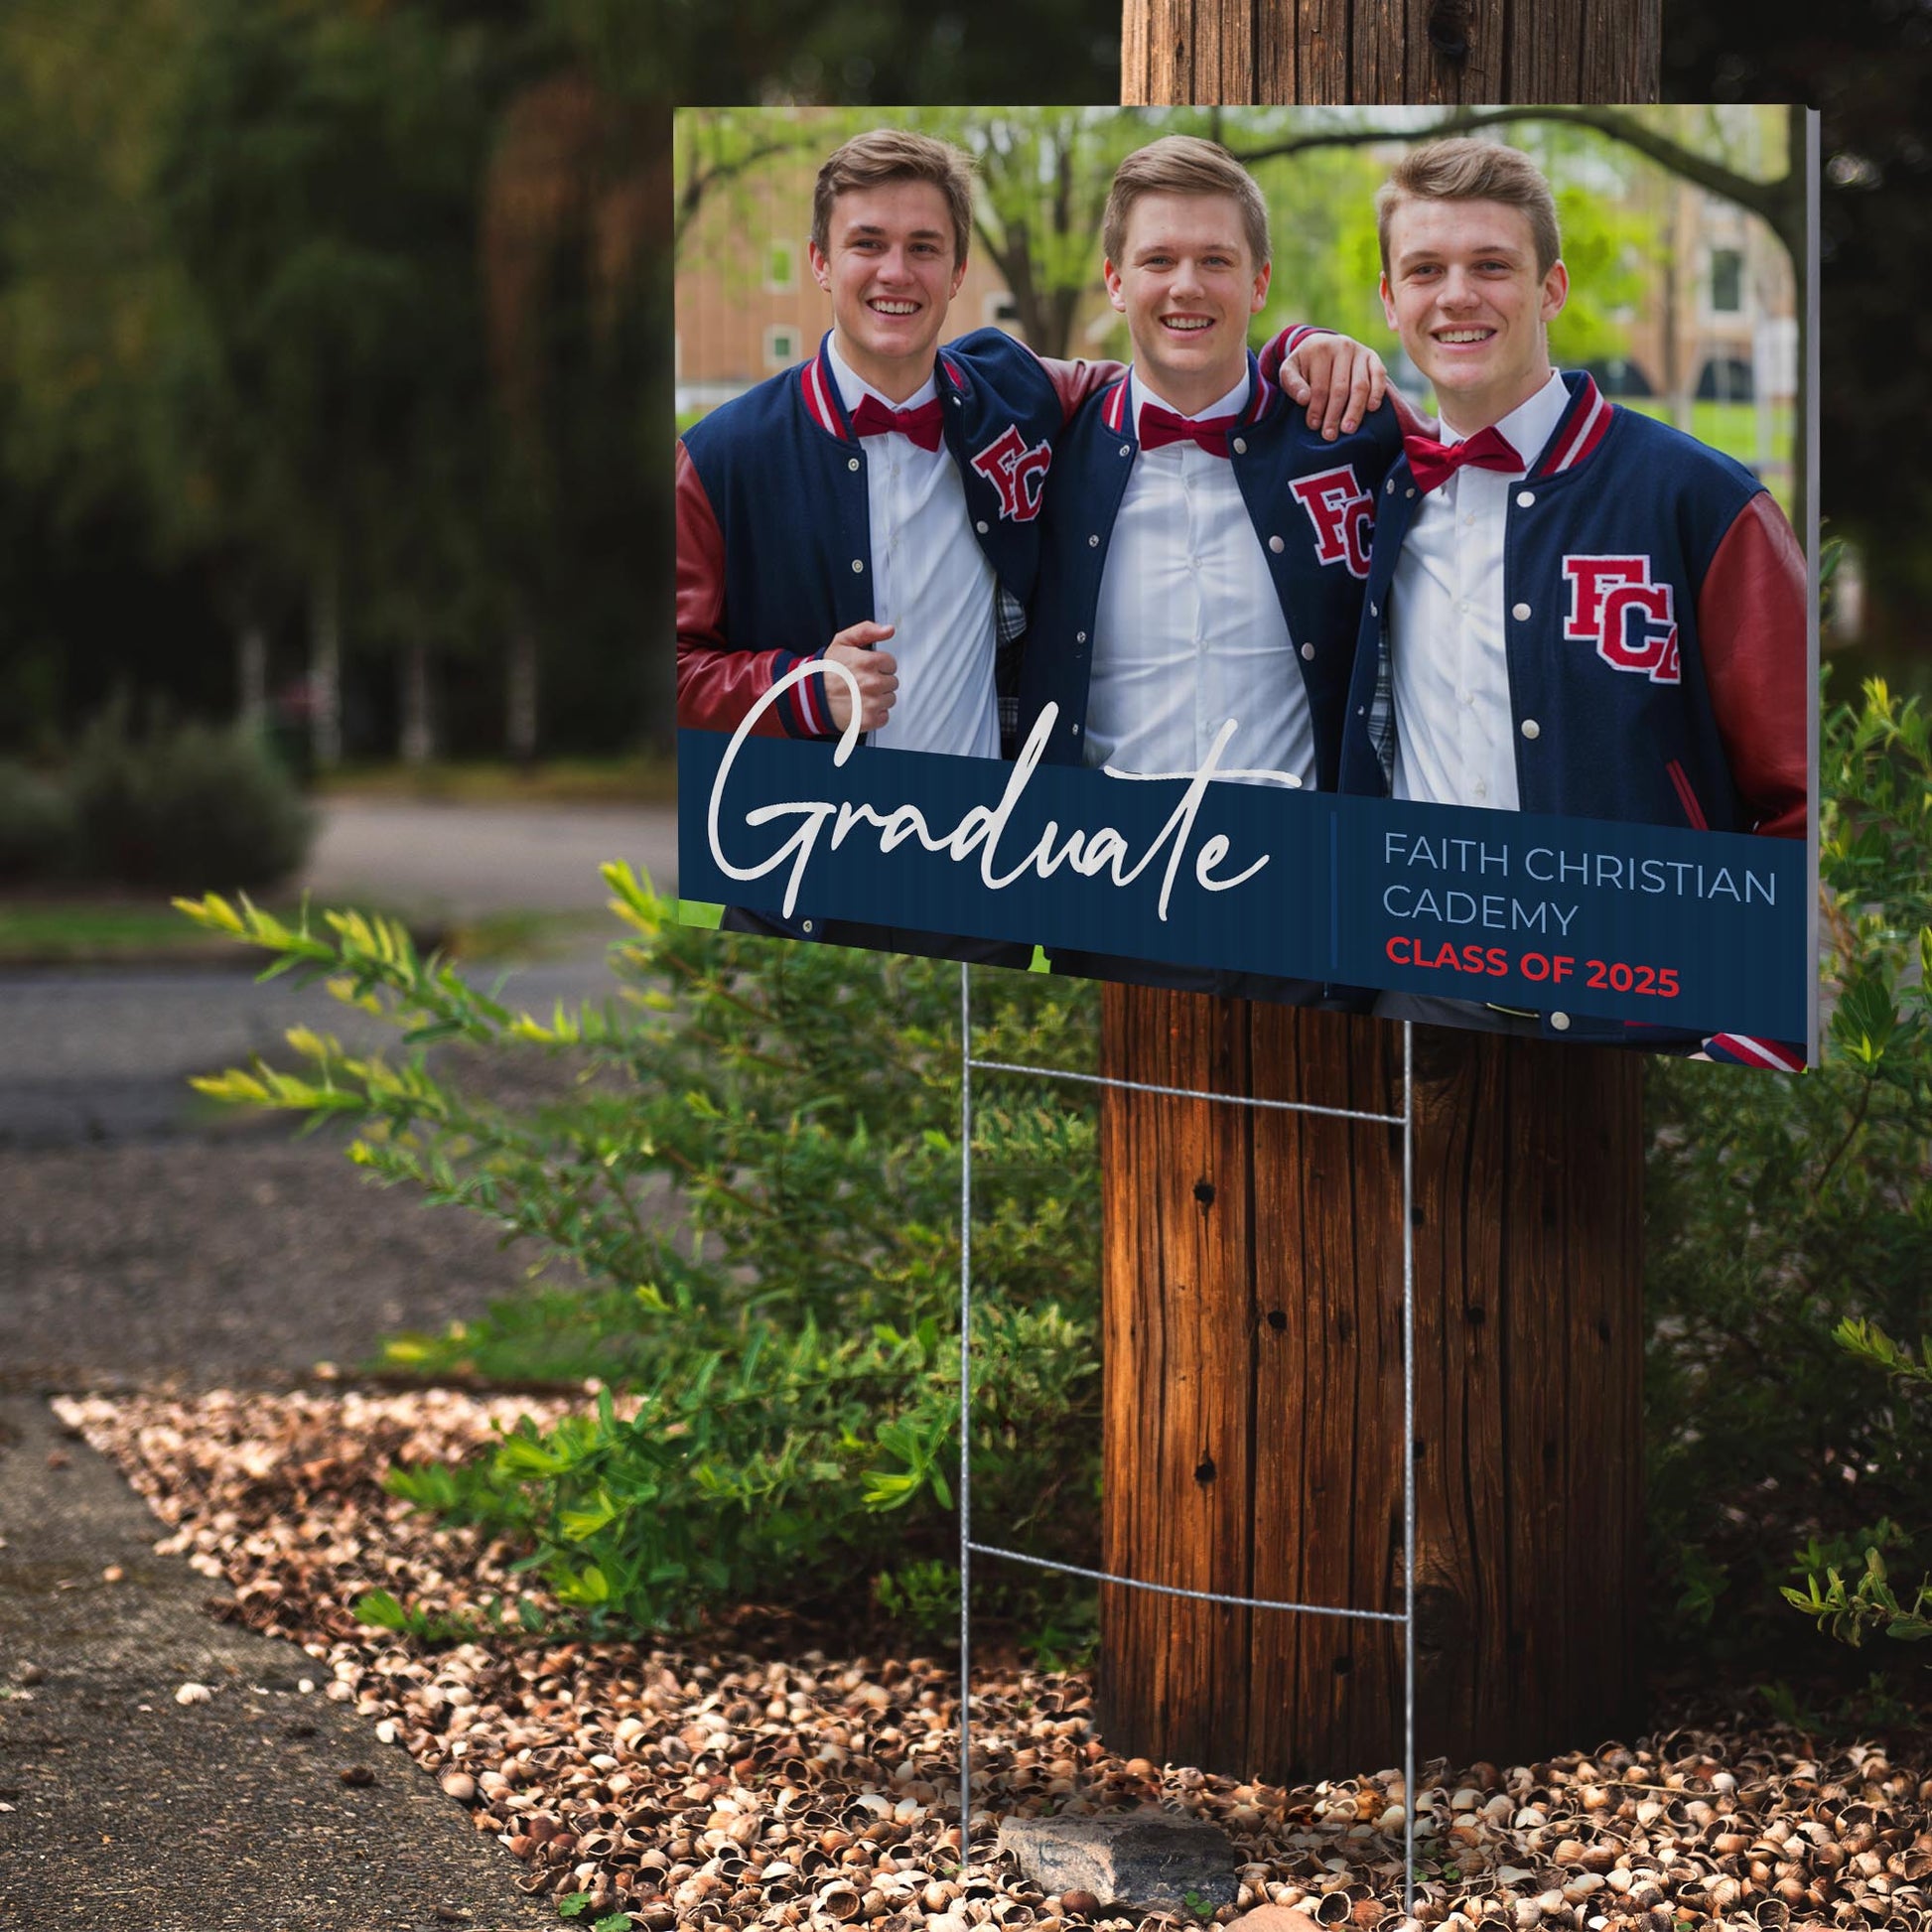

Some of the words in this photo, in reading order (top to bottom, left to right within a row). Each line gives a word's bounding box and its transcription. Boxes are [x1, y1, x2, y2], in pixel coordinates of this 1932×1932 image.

[708, 659, 1302, 920] Graduate
[1385, 832, 1508, 876] FAITH
[1525, 848, 1776, 906] CHRISTIAN
[1383, 885, 1579, 936] CADEMY
[1385, 936, 1508, 977] CLASS
[1520, 952, 1575, 983] OF
[1587, 960, 1680, 998] 2025
